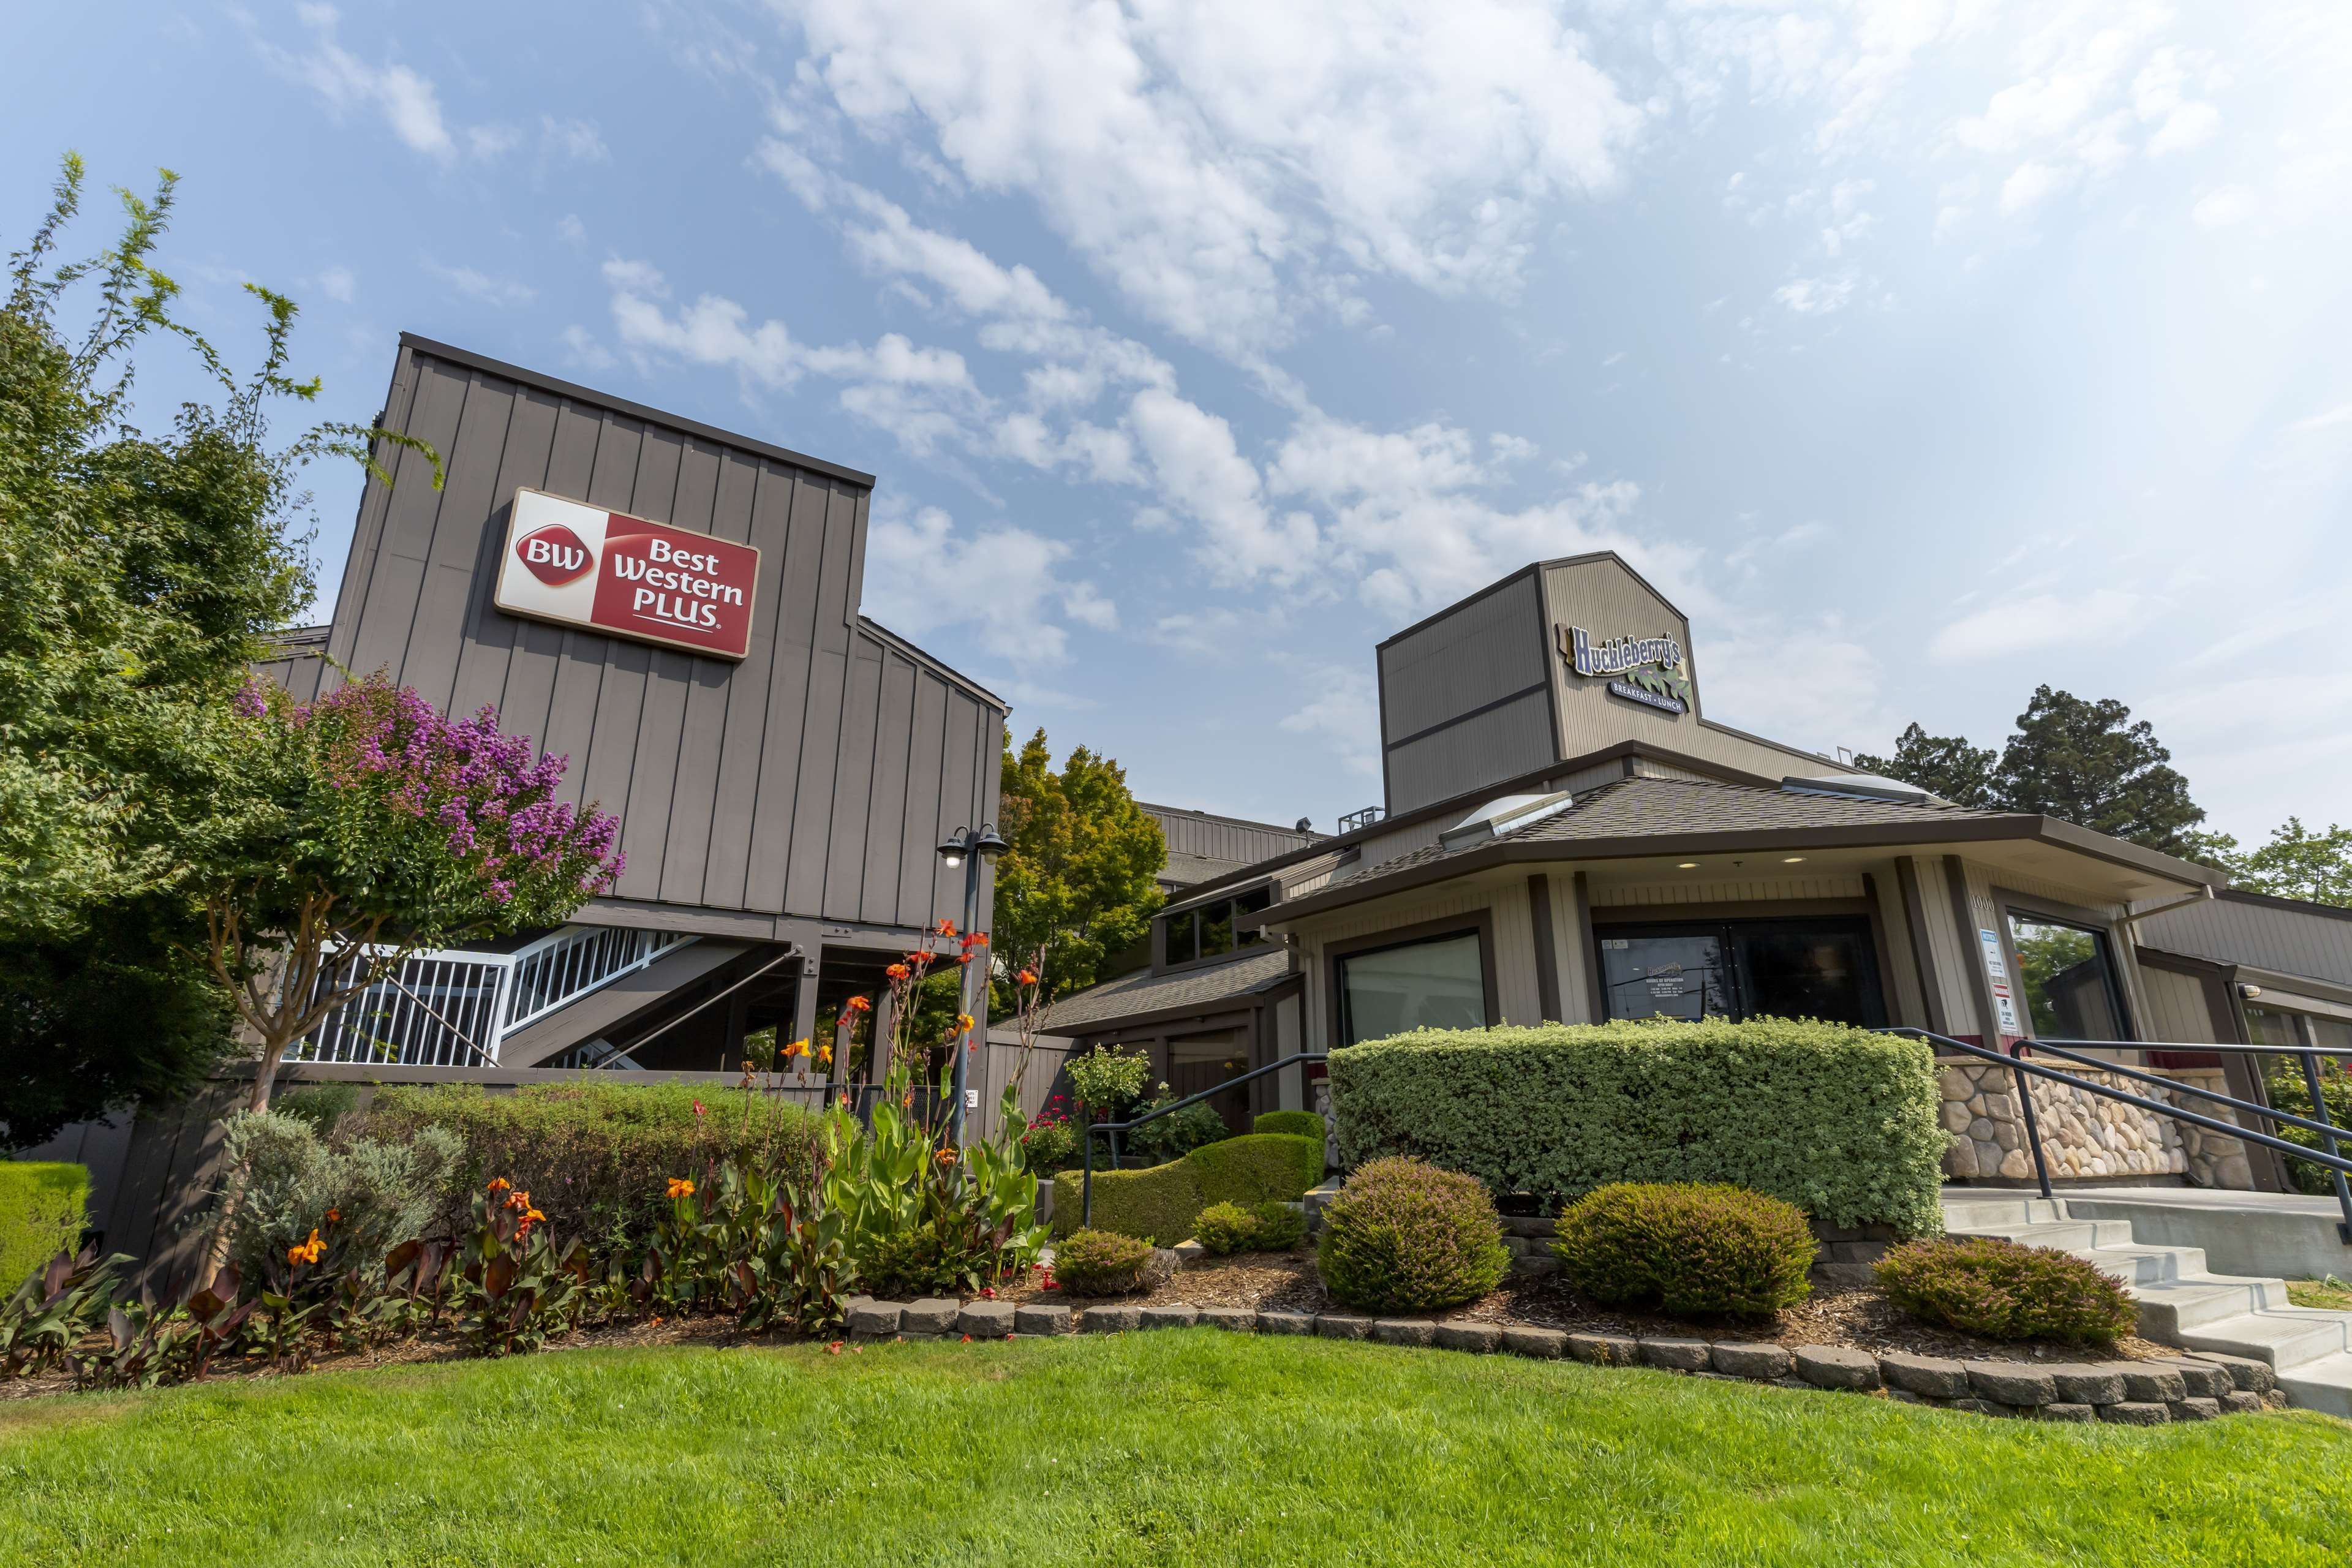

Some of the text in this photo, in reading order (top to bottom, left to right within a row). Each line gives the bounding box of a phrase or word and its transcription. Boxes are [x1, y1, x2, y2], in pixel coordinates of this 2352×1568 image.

[527, 538, 584, 571] BW
[649, 538, 720, 576] Best
[615, 554, 743, 606] Western
[633, 587, 717, 627] PLUS
[1572, 625, 1681, 676] Huckleberry's
[1614, 683, 1681, 710] BREAKFAST LUNCH
[1972, 894, 1994, 911] 1000
